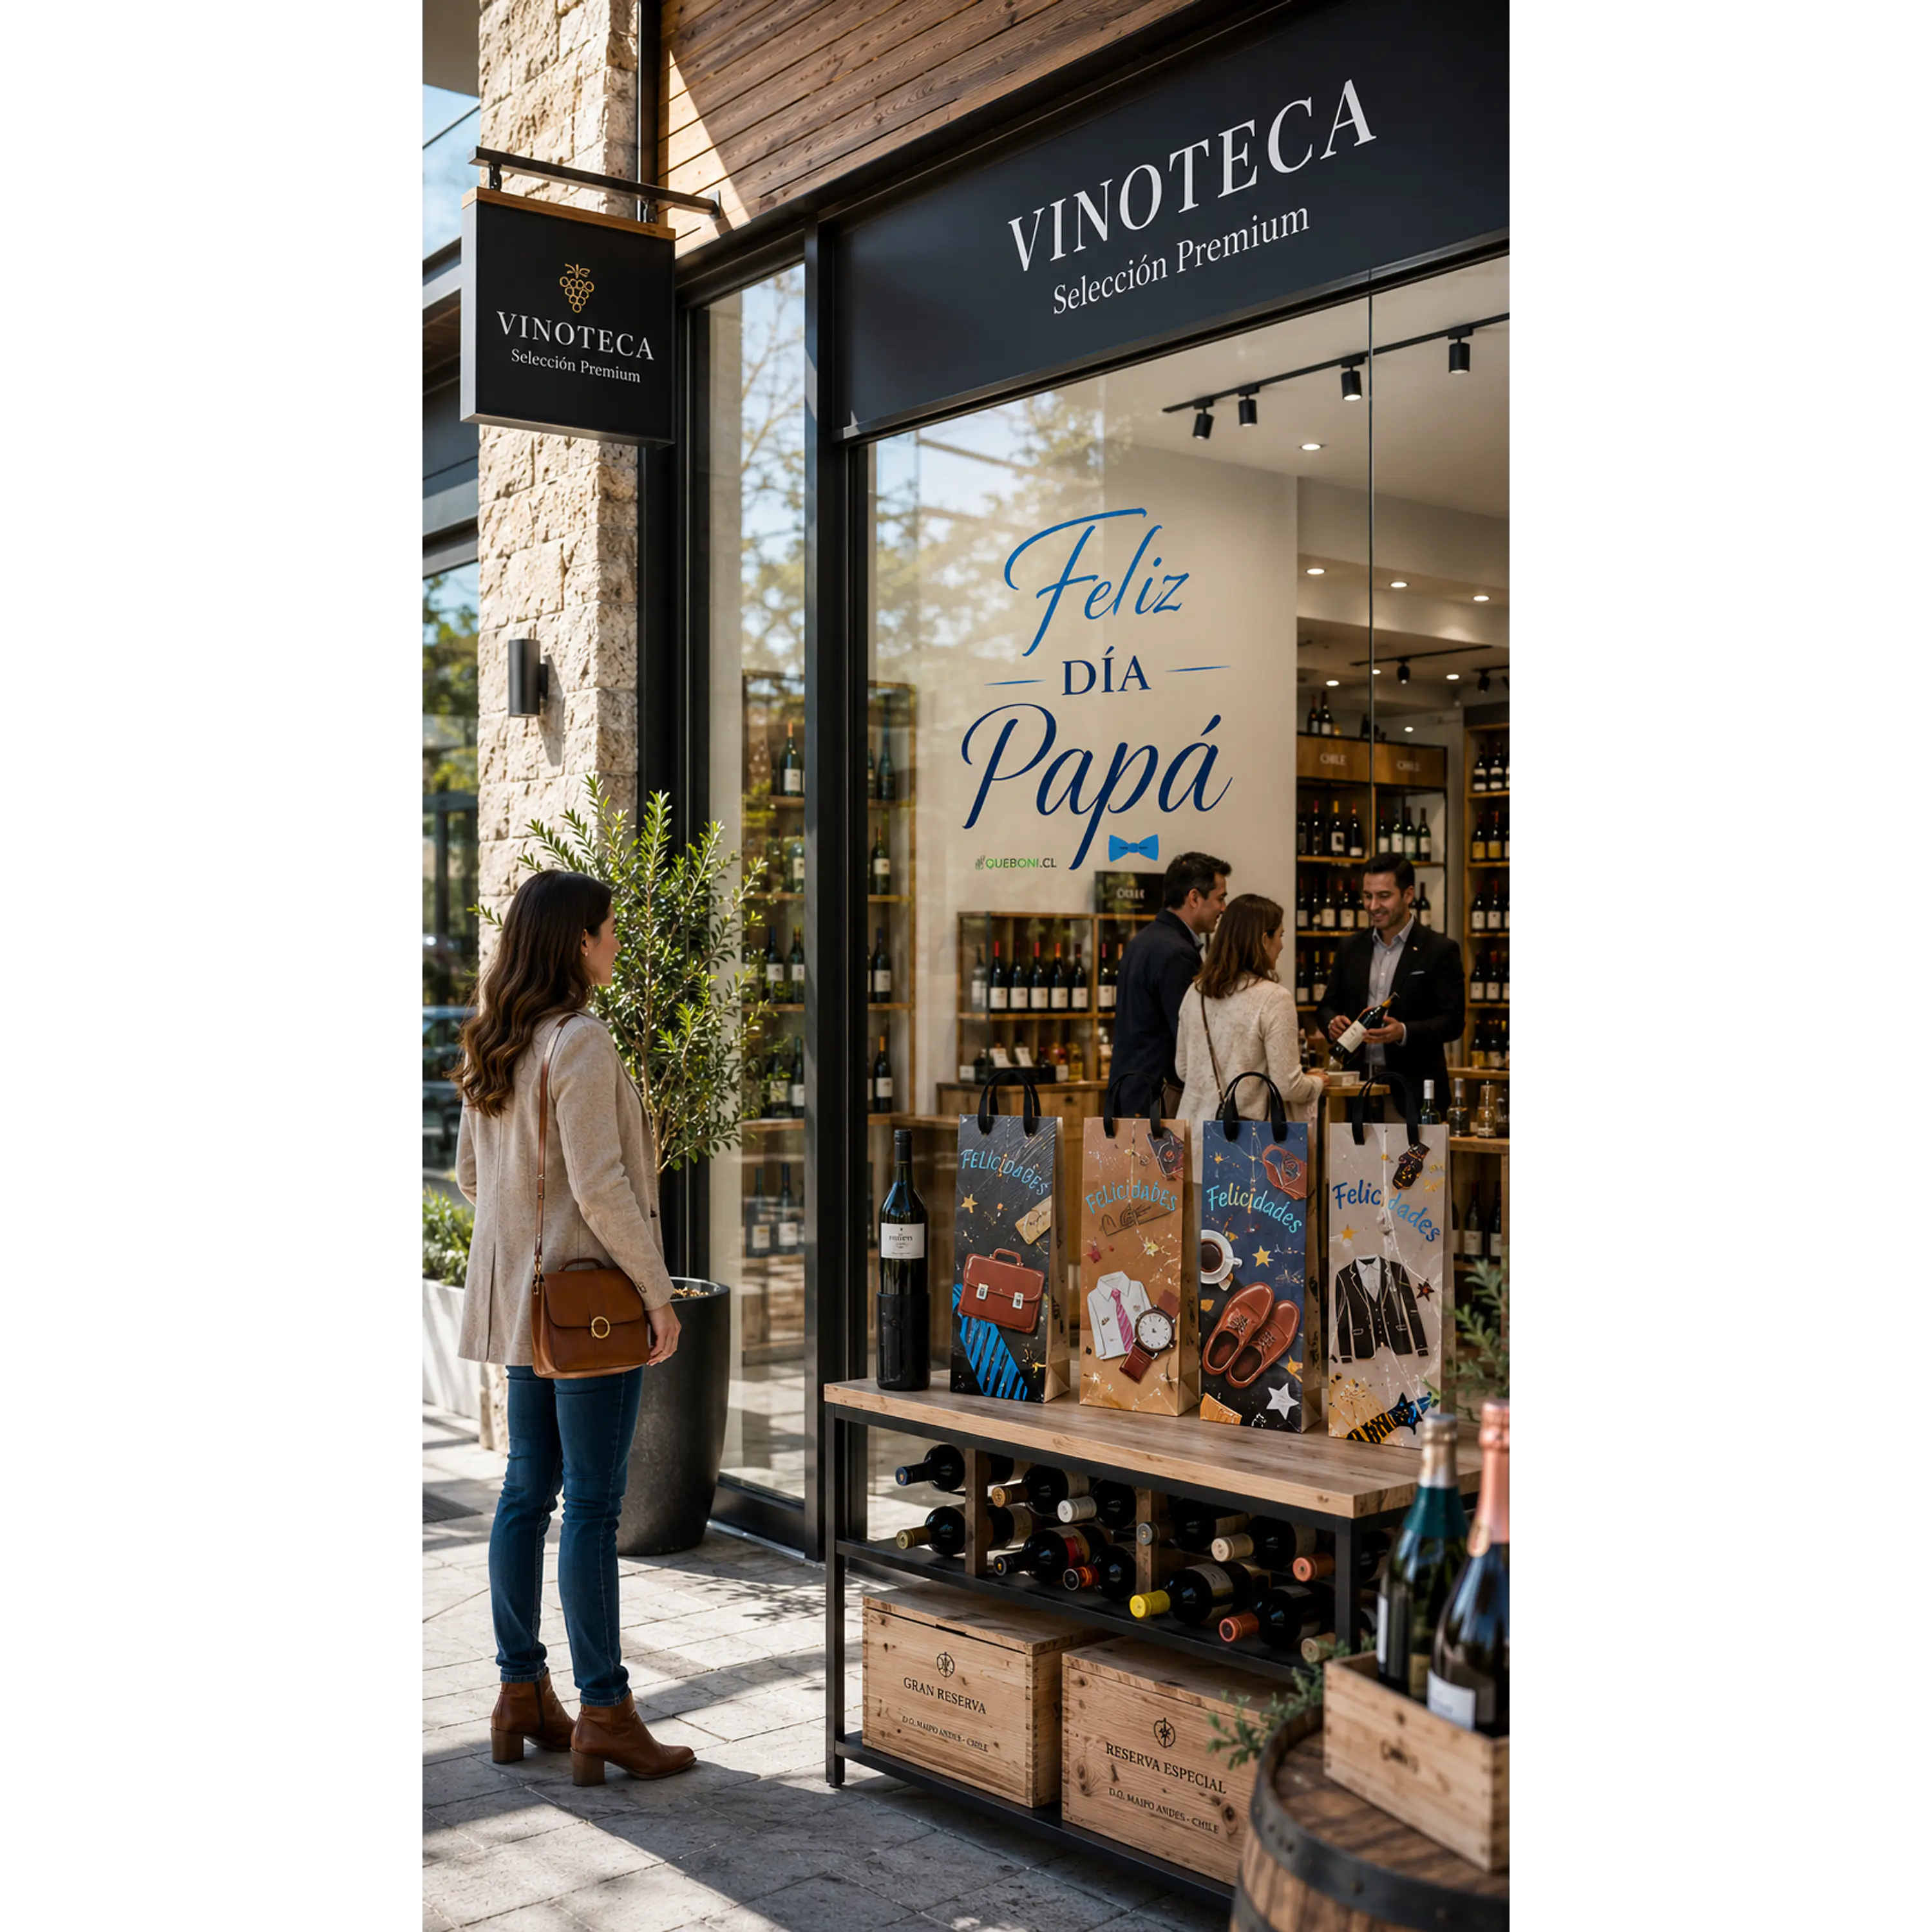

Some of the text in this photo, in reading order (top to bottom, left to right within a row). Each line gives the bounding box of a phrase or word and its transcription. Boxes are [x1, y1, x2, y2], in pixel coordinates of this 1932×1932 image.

[1007, 79, 1377, 272] VINOTECA
[1053, 207, 1311, 315] Selección Premium
[497, 310, 654, 361] VINOTECA
[511, 348, 641, 383] Selección Premium
[1003, 507, 1189, 657] Feliz
[1061, 646, 1152, 696] DÍA
[1320, 753, 1347, 766] CHILE
[961, 703, 1233, 870] Papá
[985, 857, 1057, 869] QUEBONI.CL
[1206, 1182, 1302, 1233] Felicidades
[903, 1676, 987, 1715] GRAN RESERVA
[1105, 1741, 1227, 1795] RESERVA ESPECIAL
[1191, 1817, 1219, 1834] CHILE
